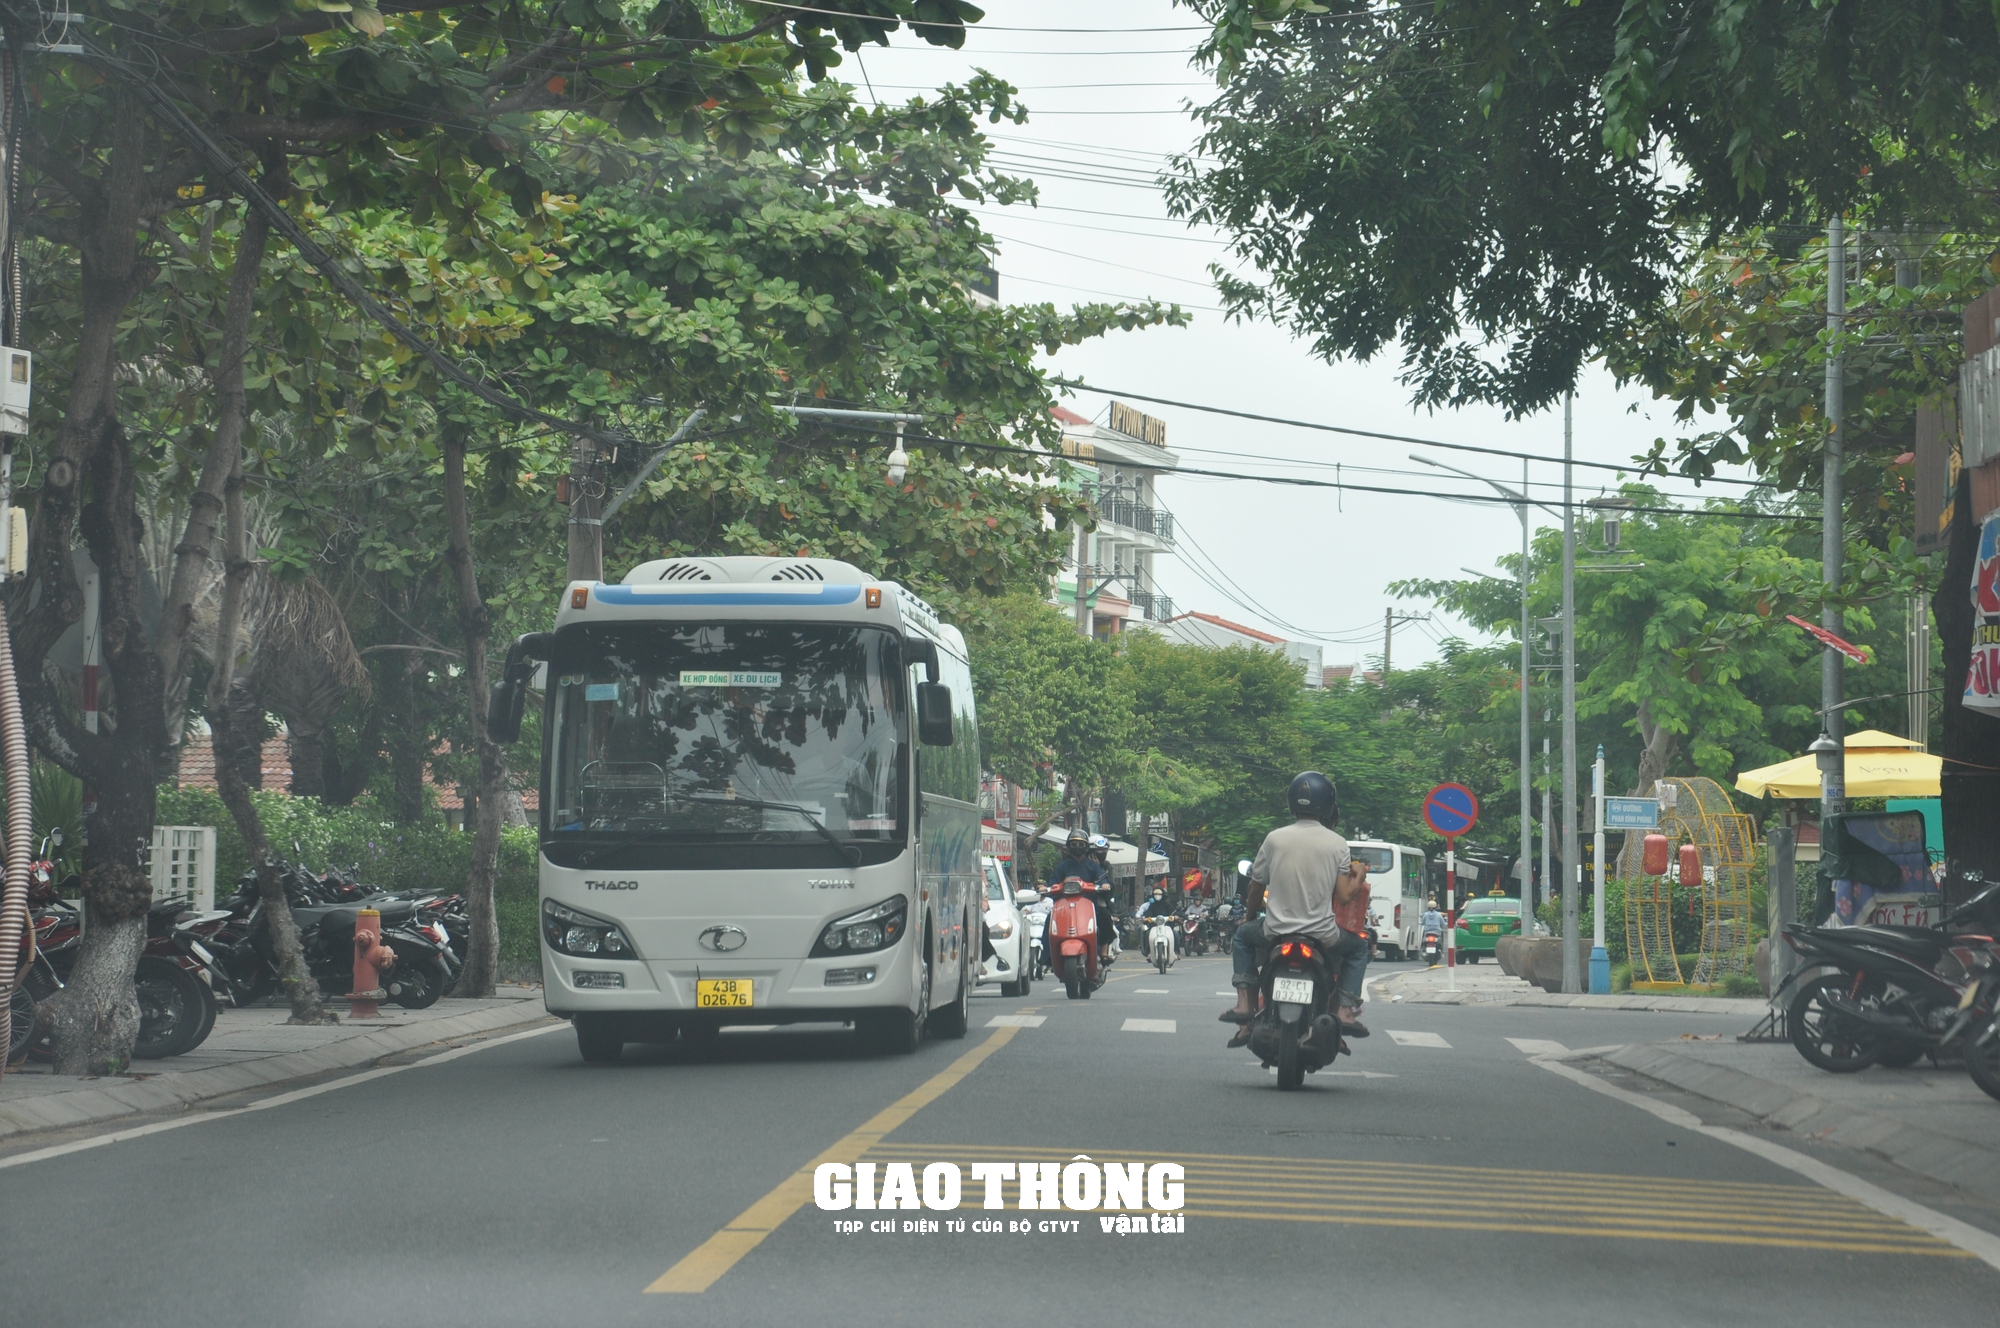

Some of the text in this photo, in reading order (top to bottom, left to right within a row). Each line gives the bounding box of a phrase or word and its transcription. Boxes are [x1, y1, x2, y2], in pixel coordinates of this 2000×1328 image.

[1111, 400, 1143, 441] UPTOWN
[683, 674, 691, 683] XE
[693, 674, 707, 685] HỢP
[733, 674, 744, 683] XE
[746, 674, 757, 684] DU
[759, 675, 778, 685] LỊCH
[1611, 814, 1625, 823] PHAN
[995, 839, 1011, 853] NGA
[585, 879, 855, 891] THACO TOWN
[713, 981, 737, 993] 43B
[703, 994, 747, 1006] 026.76
